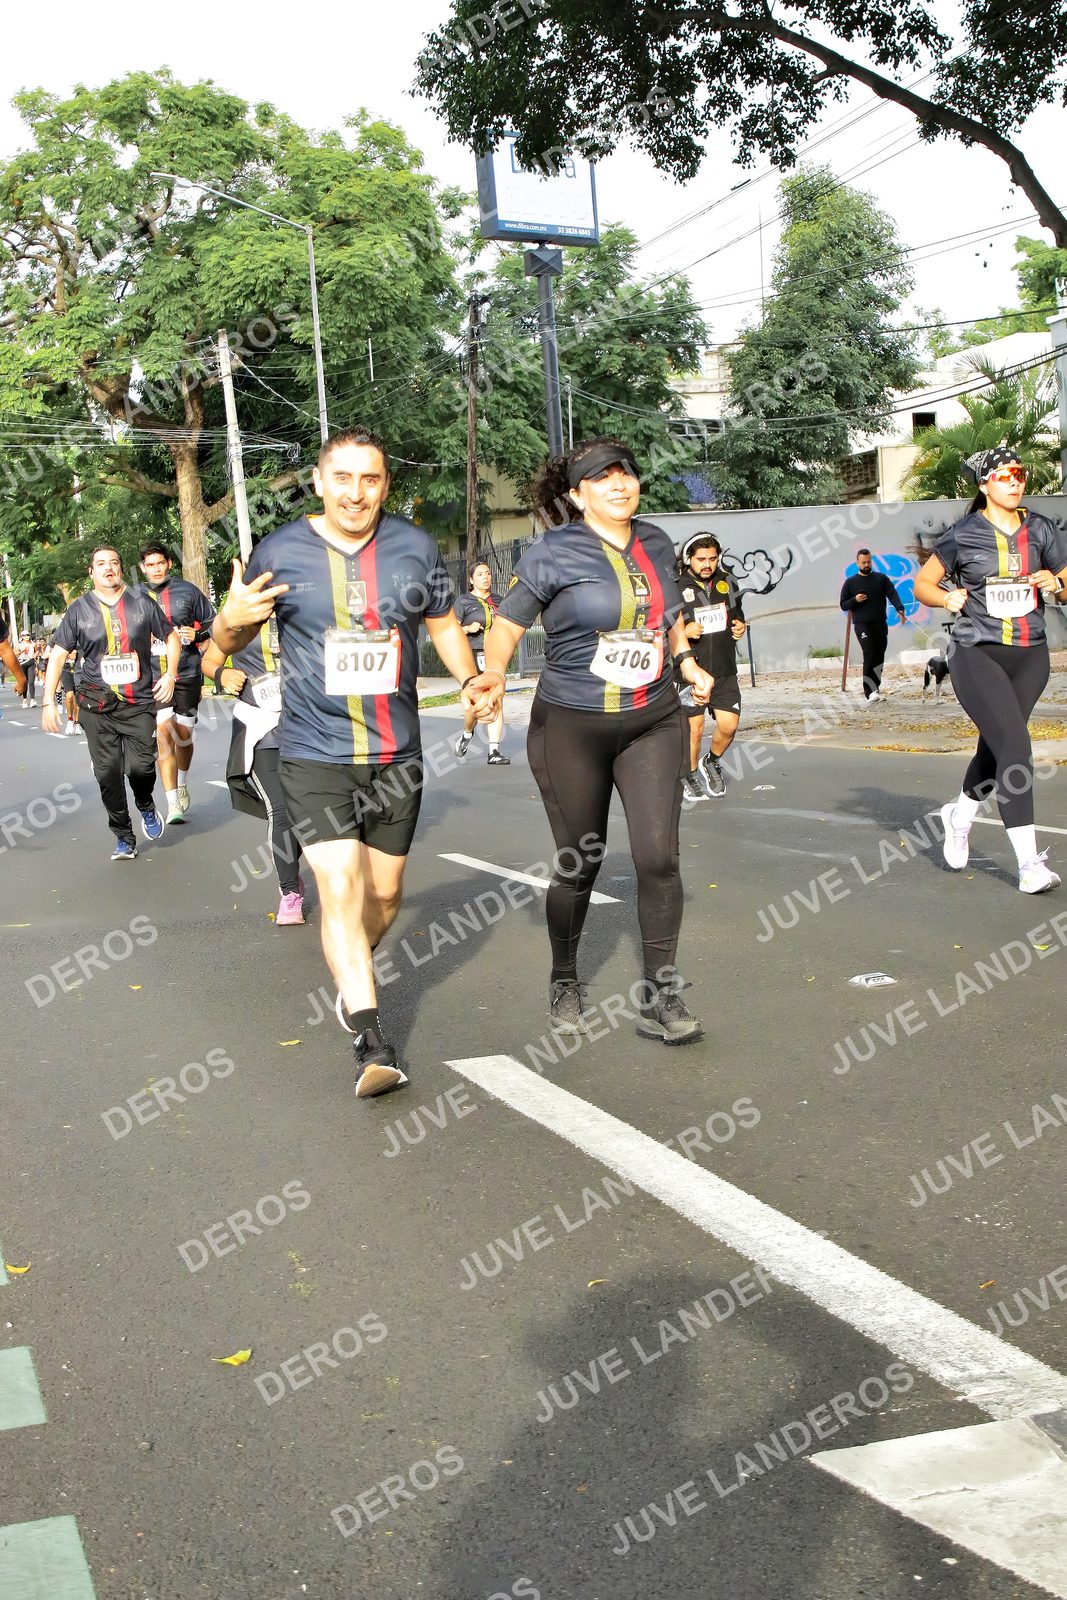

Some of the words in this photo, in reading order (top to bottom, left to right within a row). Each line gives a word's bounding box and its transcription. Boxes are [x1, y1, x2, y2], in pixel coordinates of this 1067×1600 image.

[989, 588, 1031, 603] 10017
[336, 651, 388, 672] 8107
[605, 648, 650, 670] 8106
[103, 663, 134, 675] 11001
